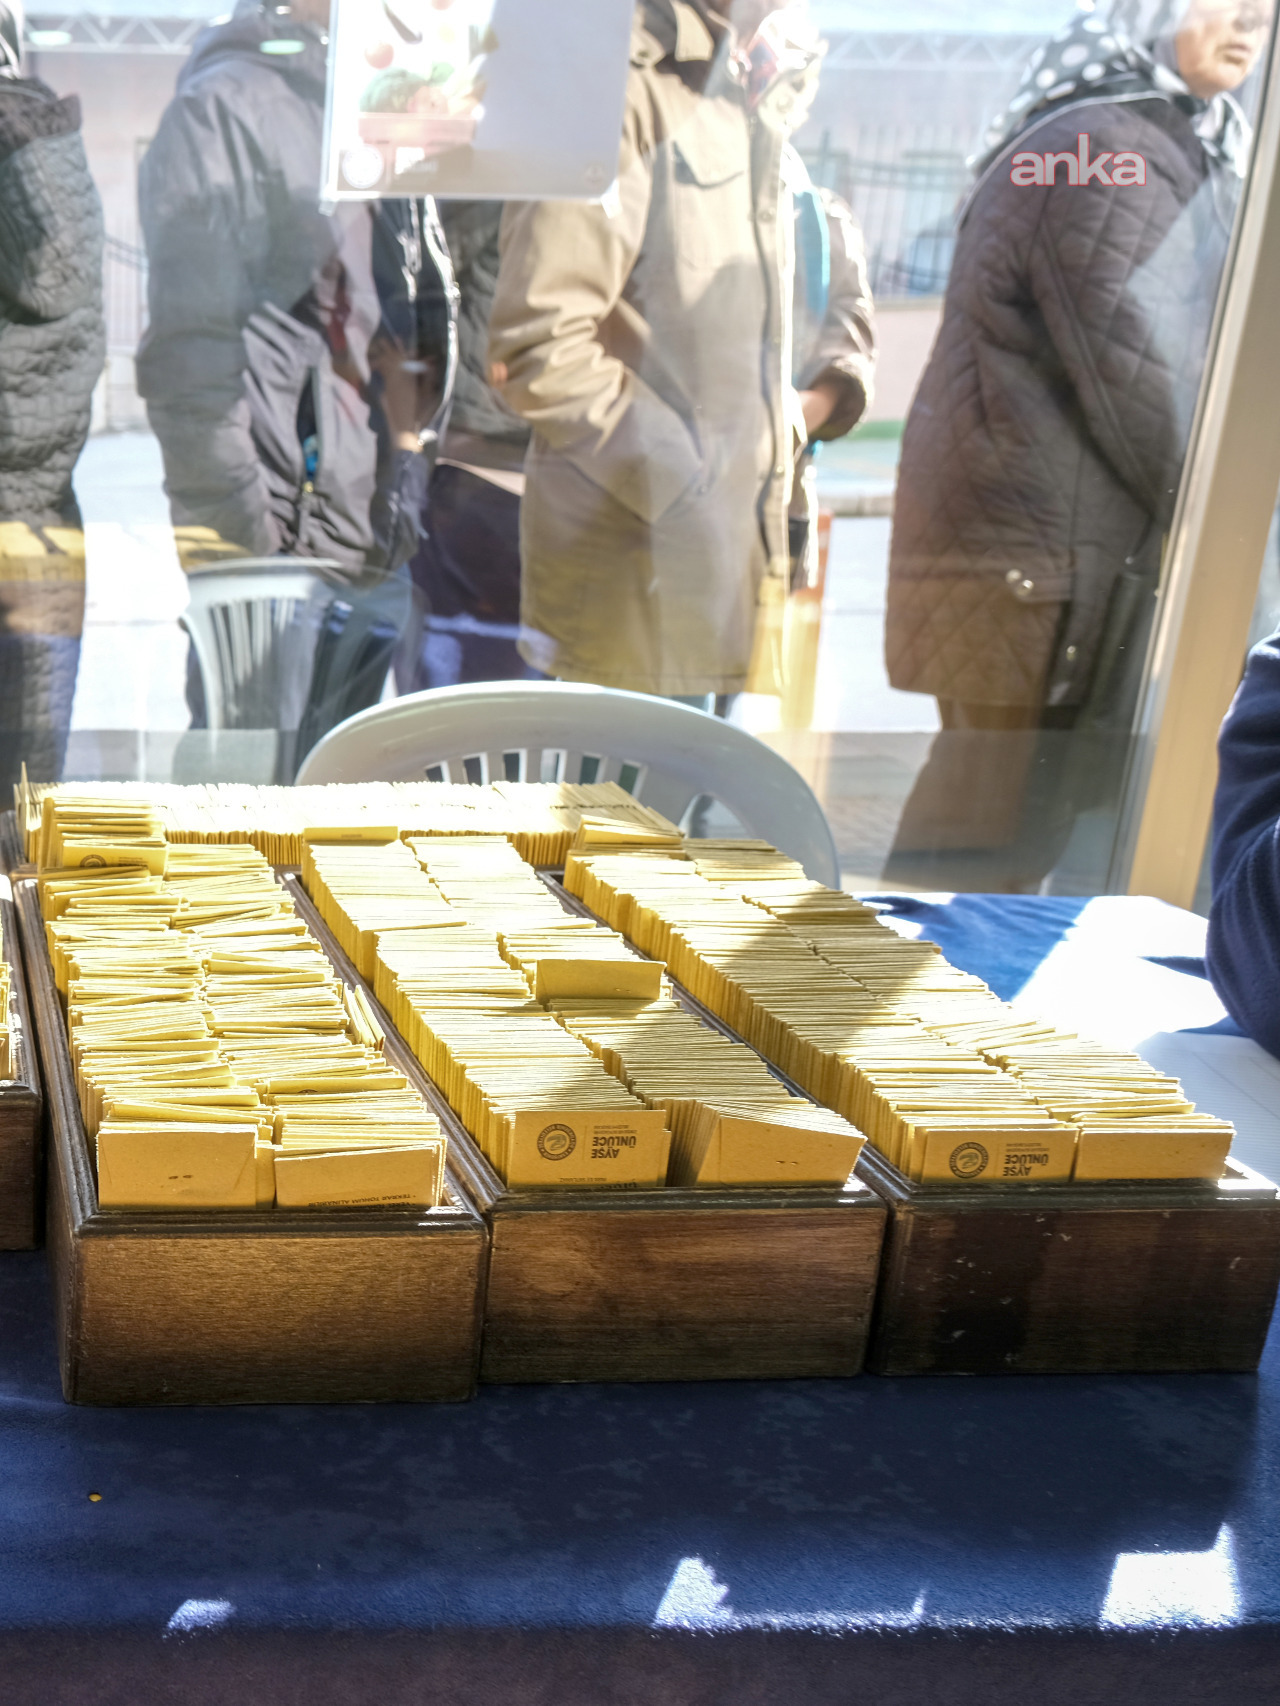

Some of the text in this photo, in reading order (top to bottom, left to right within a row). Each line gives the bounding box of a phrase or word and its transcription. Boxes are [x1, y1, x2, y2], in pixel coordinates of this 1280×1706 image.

[592, 1136, 636, 1149] ÜNLÜCE
[591, 1147, 620, 1159] AYŞE
[1003, 1165, 1032, 1177] AYŞE
